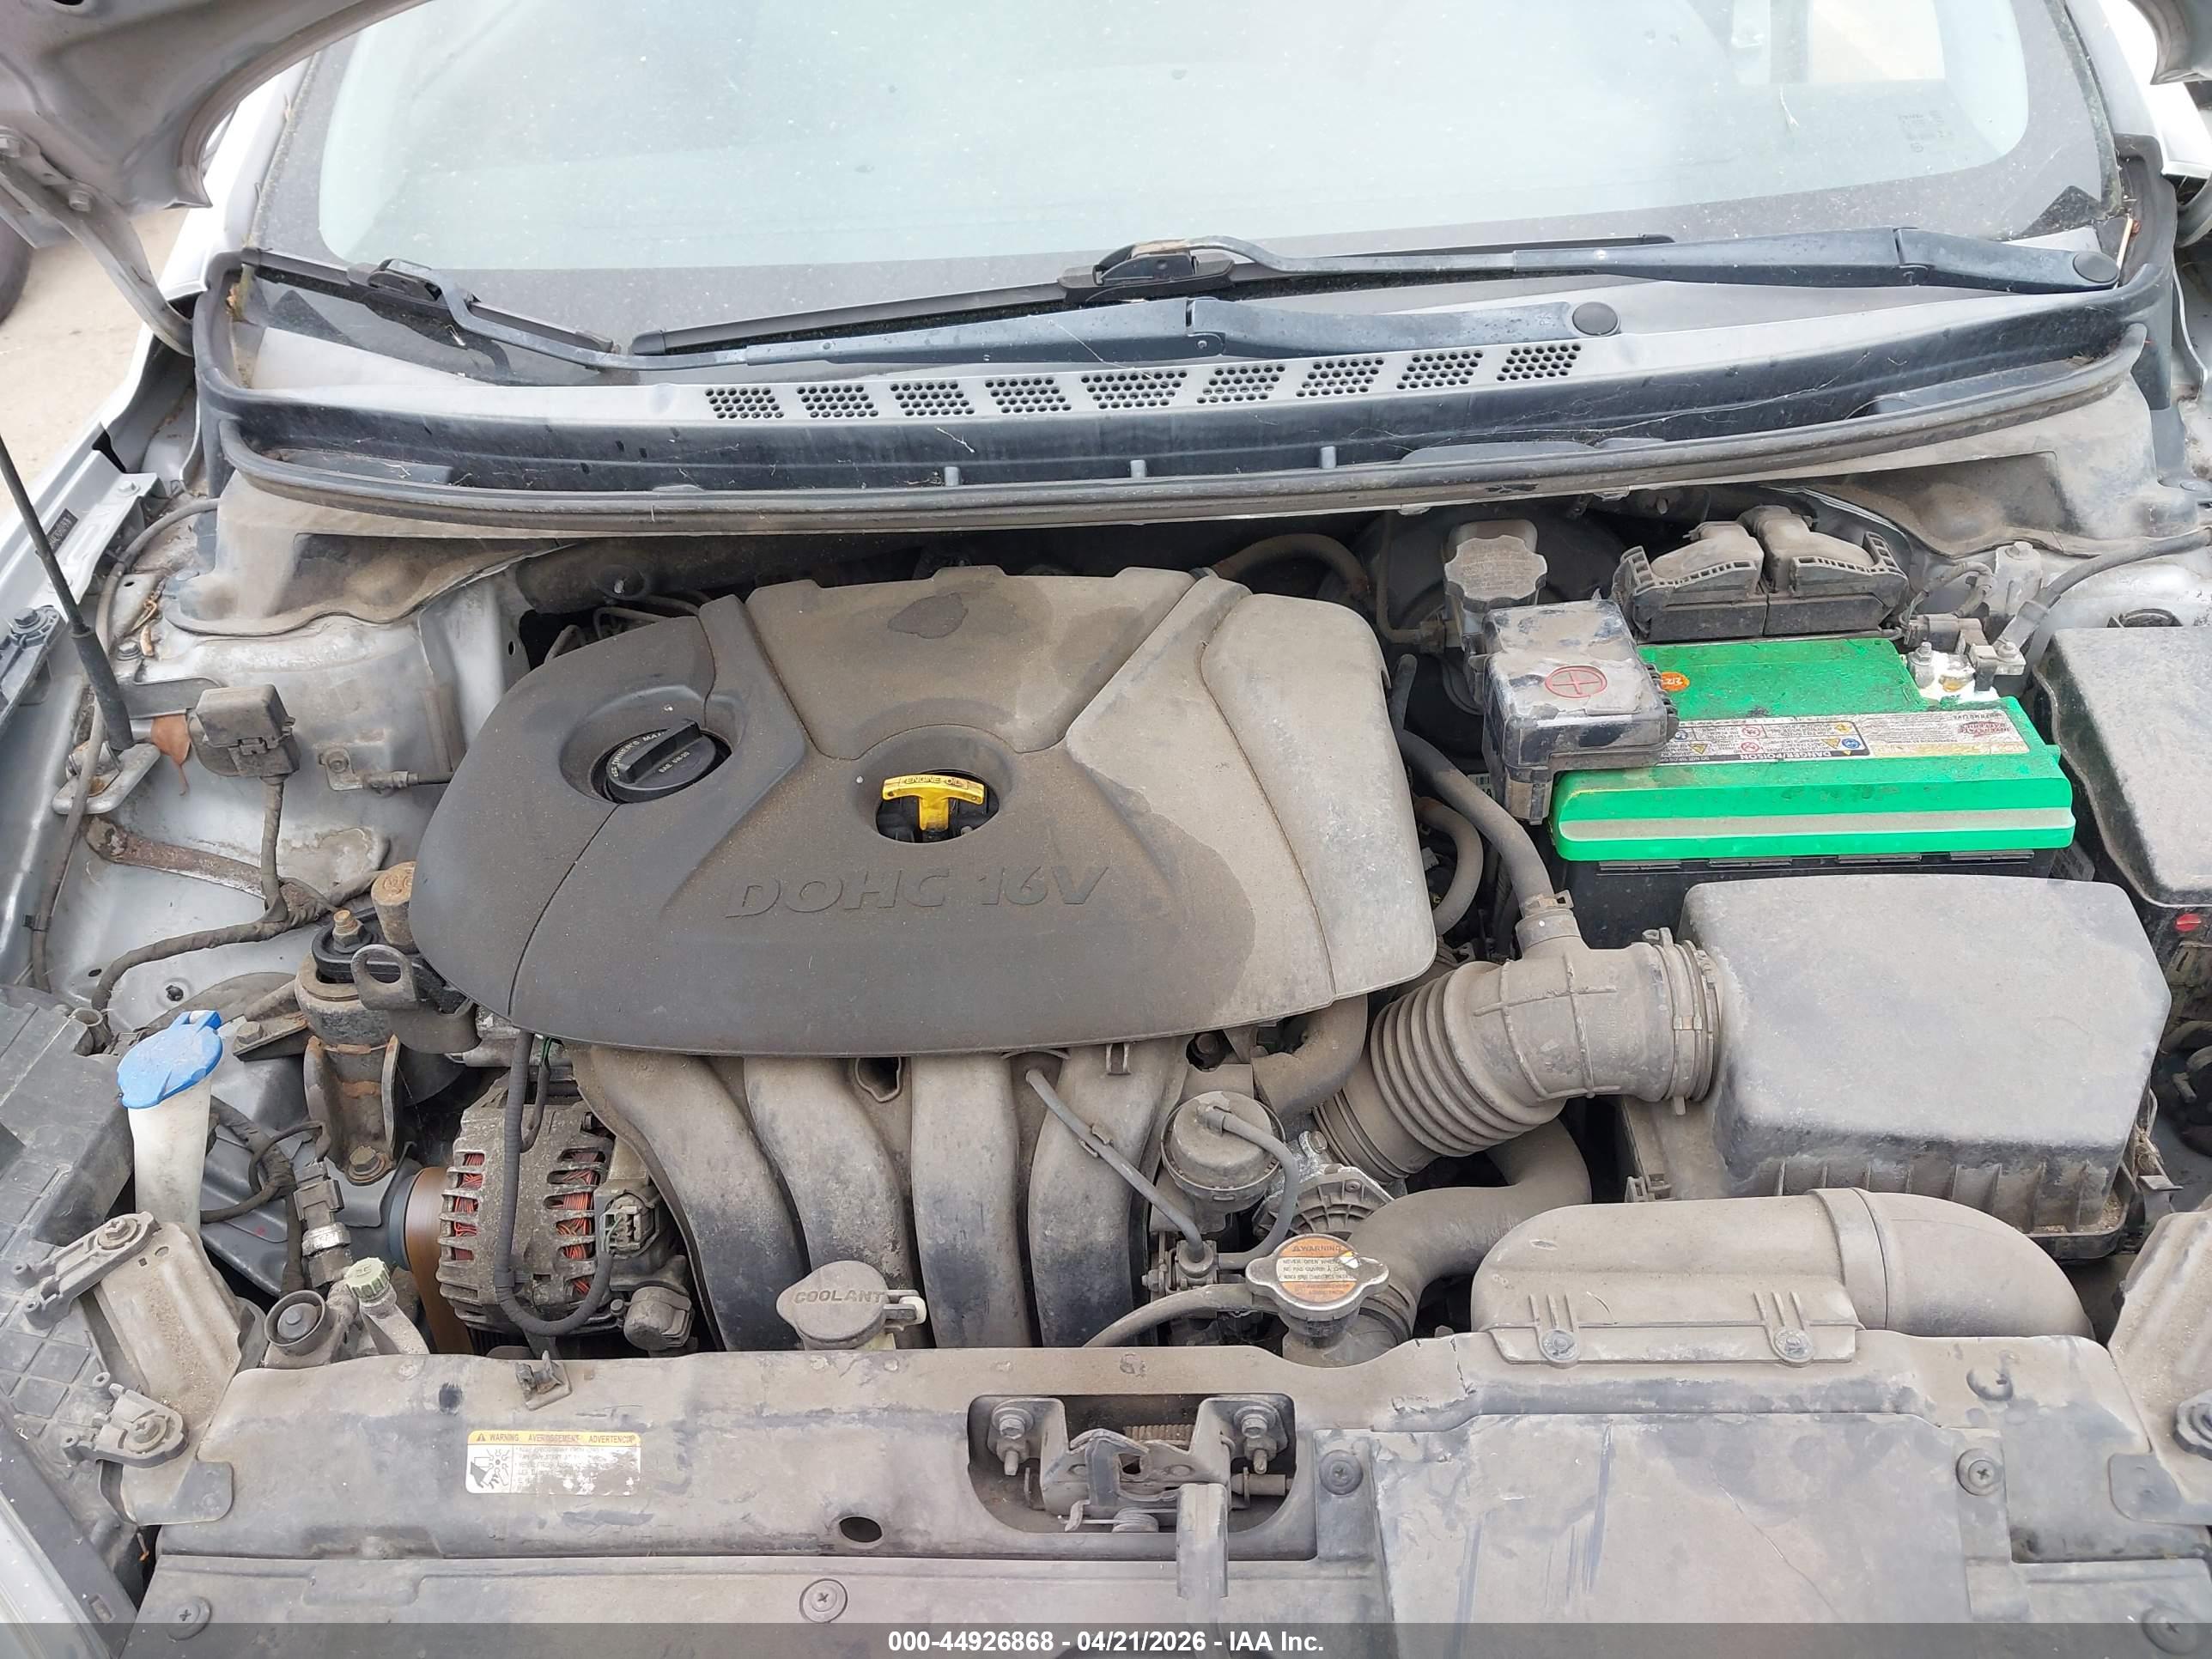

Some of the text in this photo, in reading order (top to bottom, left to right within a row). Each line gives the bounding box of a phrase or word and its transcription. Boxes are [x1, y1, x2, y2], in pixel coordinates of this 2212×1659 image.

[1740, 750, 1832, 760] DANGER/POISON
[905, 775, 941, 785] ENGINE
[725, 866, 1109, 919] DOHC 16V
[1300, 1244, 1341, 1253] WARNING
[794, 1289, 884, 1304] COOLANT
[490, 1433, 520, 1442] WARNING
